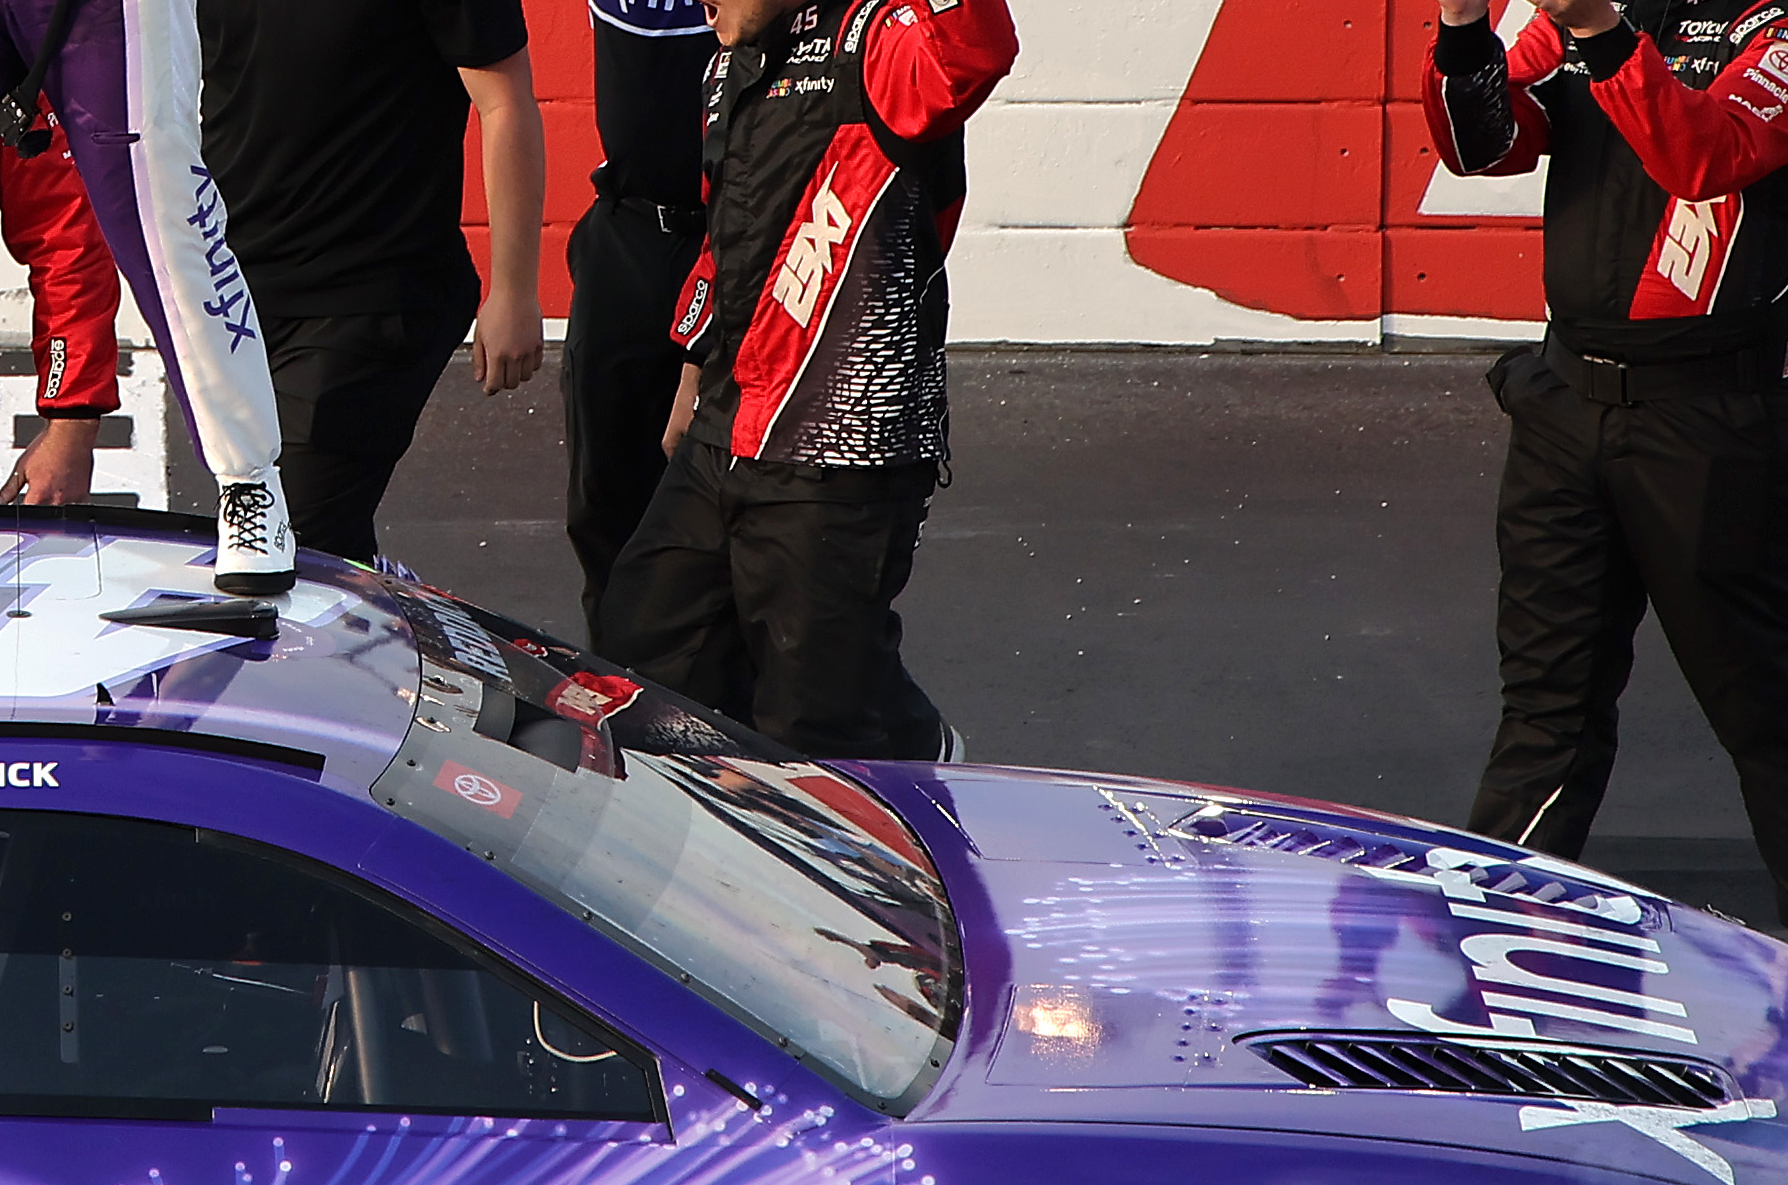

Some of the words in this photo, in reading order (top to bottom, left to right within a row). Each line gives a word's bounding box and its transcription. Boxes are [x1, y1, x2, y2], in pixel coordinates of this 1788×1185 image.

[790, 5, 818, 35] 45
[1728, 7, 1785, 46] sparco
[794, 75, 836, 95] xfinity
[676, 278, 710, 335] sparco
[42, 338, 66, 399] sparco
